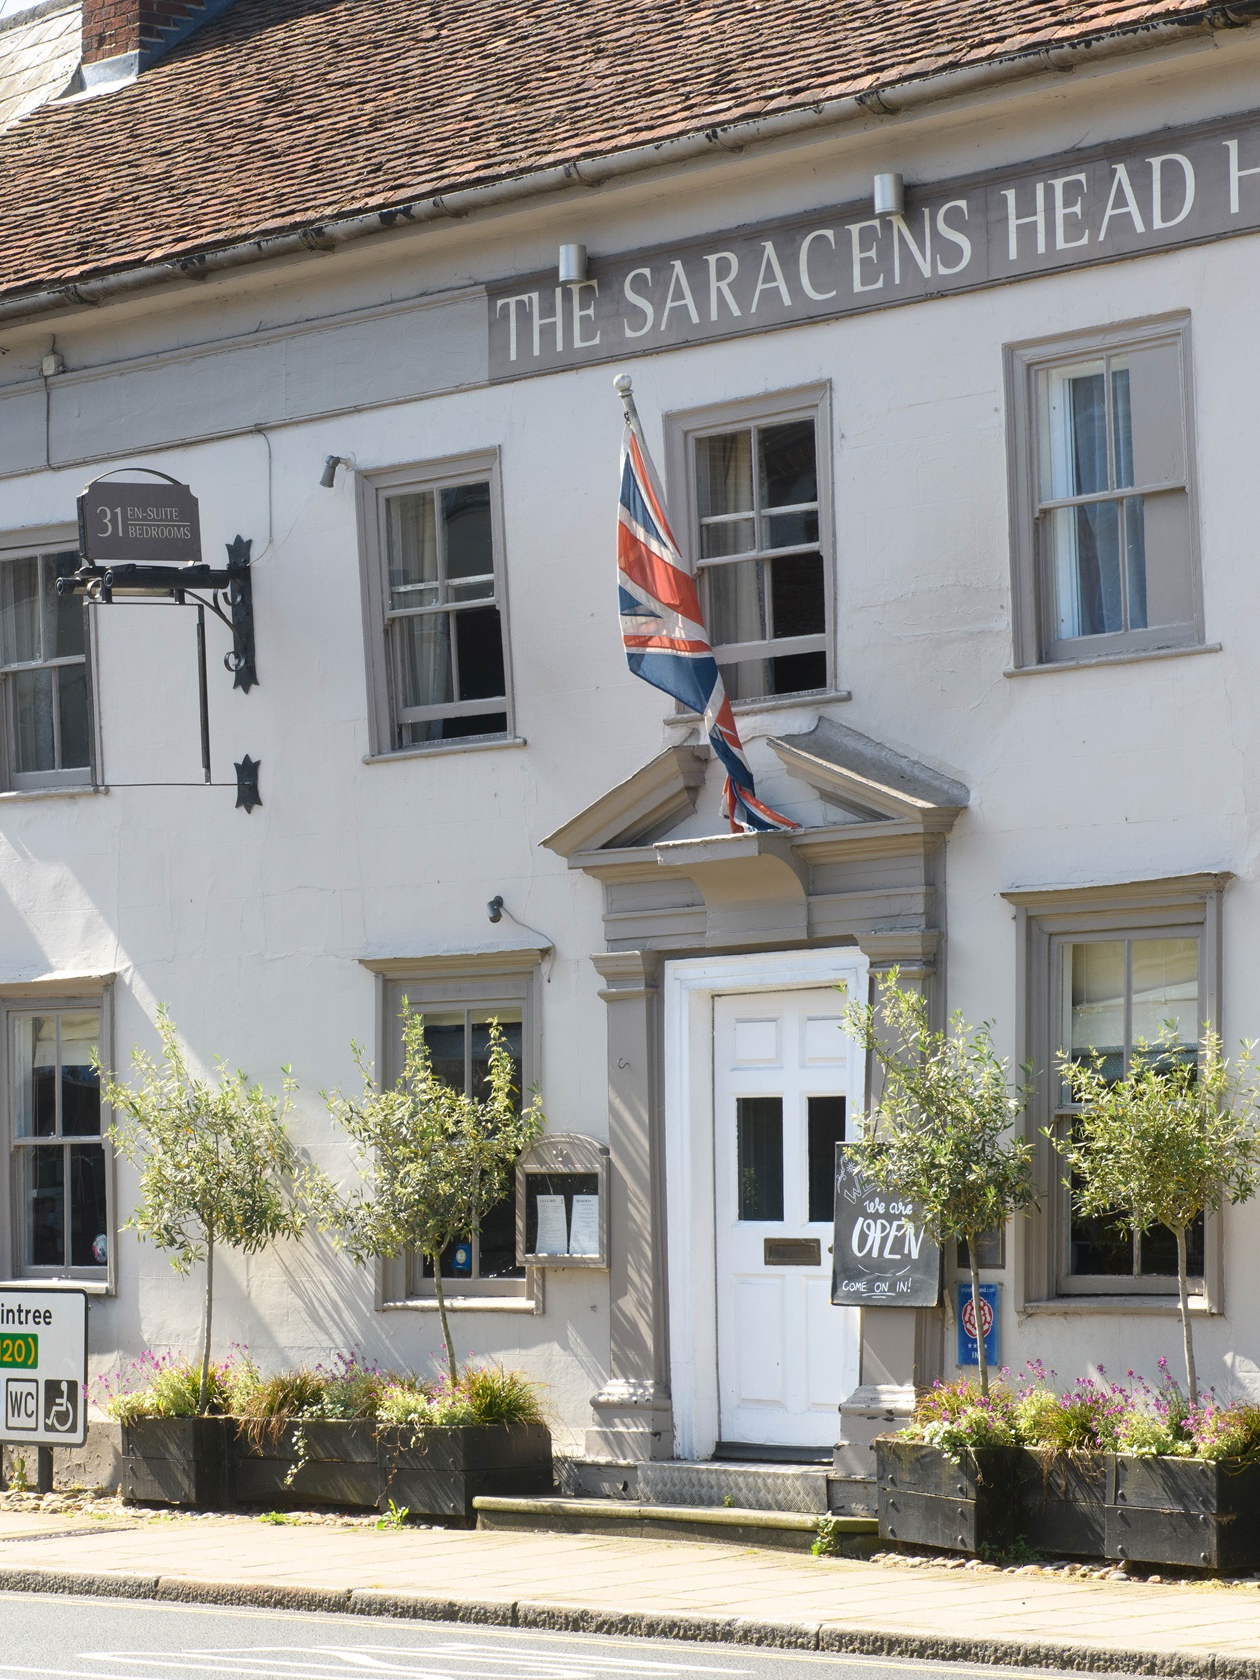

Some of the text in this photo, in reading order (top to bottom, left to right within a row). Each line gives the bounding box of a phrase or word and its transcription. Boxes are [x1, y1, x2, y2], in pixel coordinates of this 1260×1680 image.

[497, 279, 601, 362] THE
[624, 199, 972, 338] SARACENS
[1000, 153, 1196, 260] HEAD
[96, 506, 123, 537] 31
[127, 506, 180, 520] EN-SUITE
[128, 526, 191, 539] BEDROOMS
[889, 1202, 913, 1215] are
[852, 1216, 926, 1259] OPEN
[842, 1278, 912, 1293] COME ON IN!
[9, 1391, 35, 1419] WC
